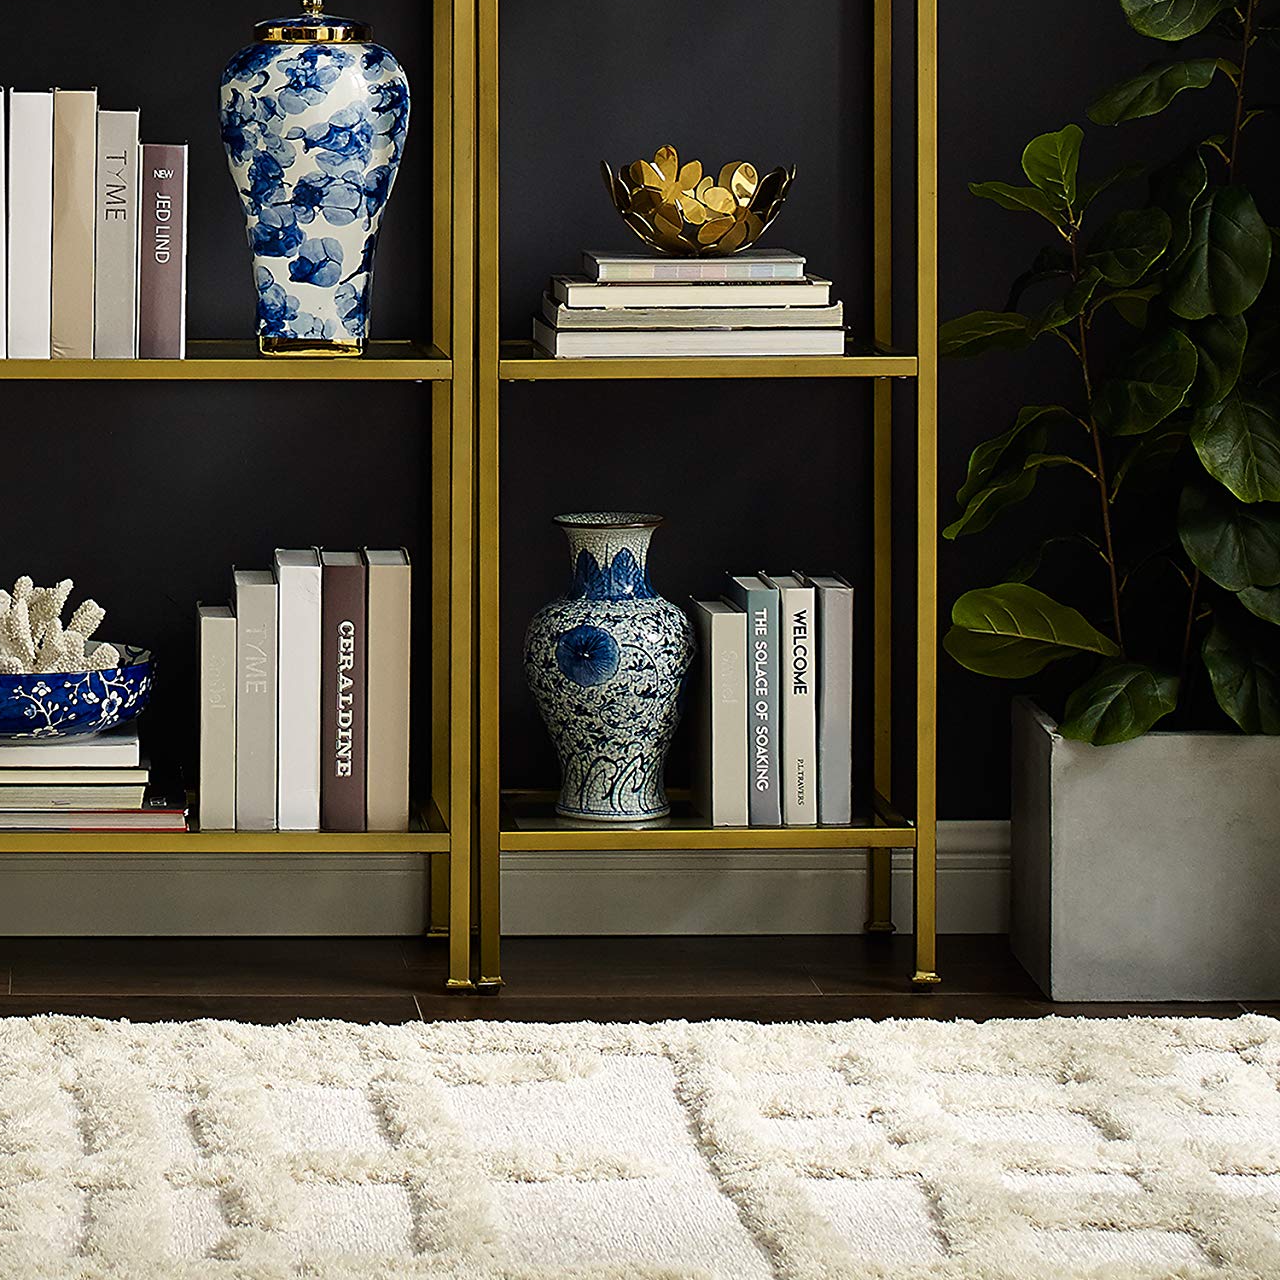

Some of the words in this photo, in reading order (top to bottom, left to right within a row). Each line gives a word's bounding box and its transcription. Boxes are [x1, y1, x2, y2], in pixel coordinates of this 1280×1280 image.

[105, 150, 128, 221] TYME
[153, 169, 174, 179] NEW
[156, 191, 172, 222] JED
[154, 225, 171, 264] LIND
[754, 607, 768, 636] THE
[754, 641, 768, 697] SOLACE
[792, 609, 808, 696] WELCOME
[755, 700, 769, 721] OF
[755, 726, 770, 792] SOAKING
